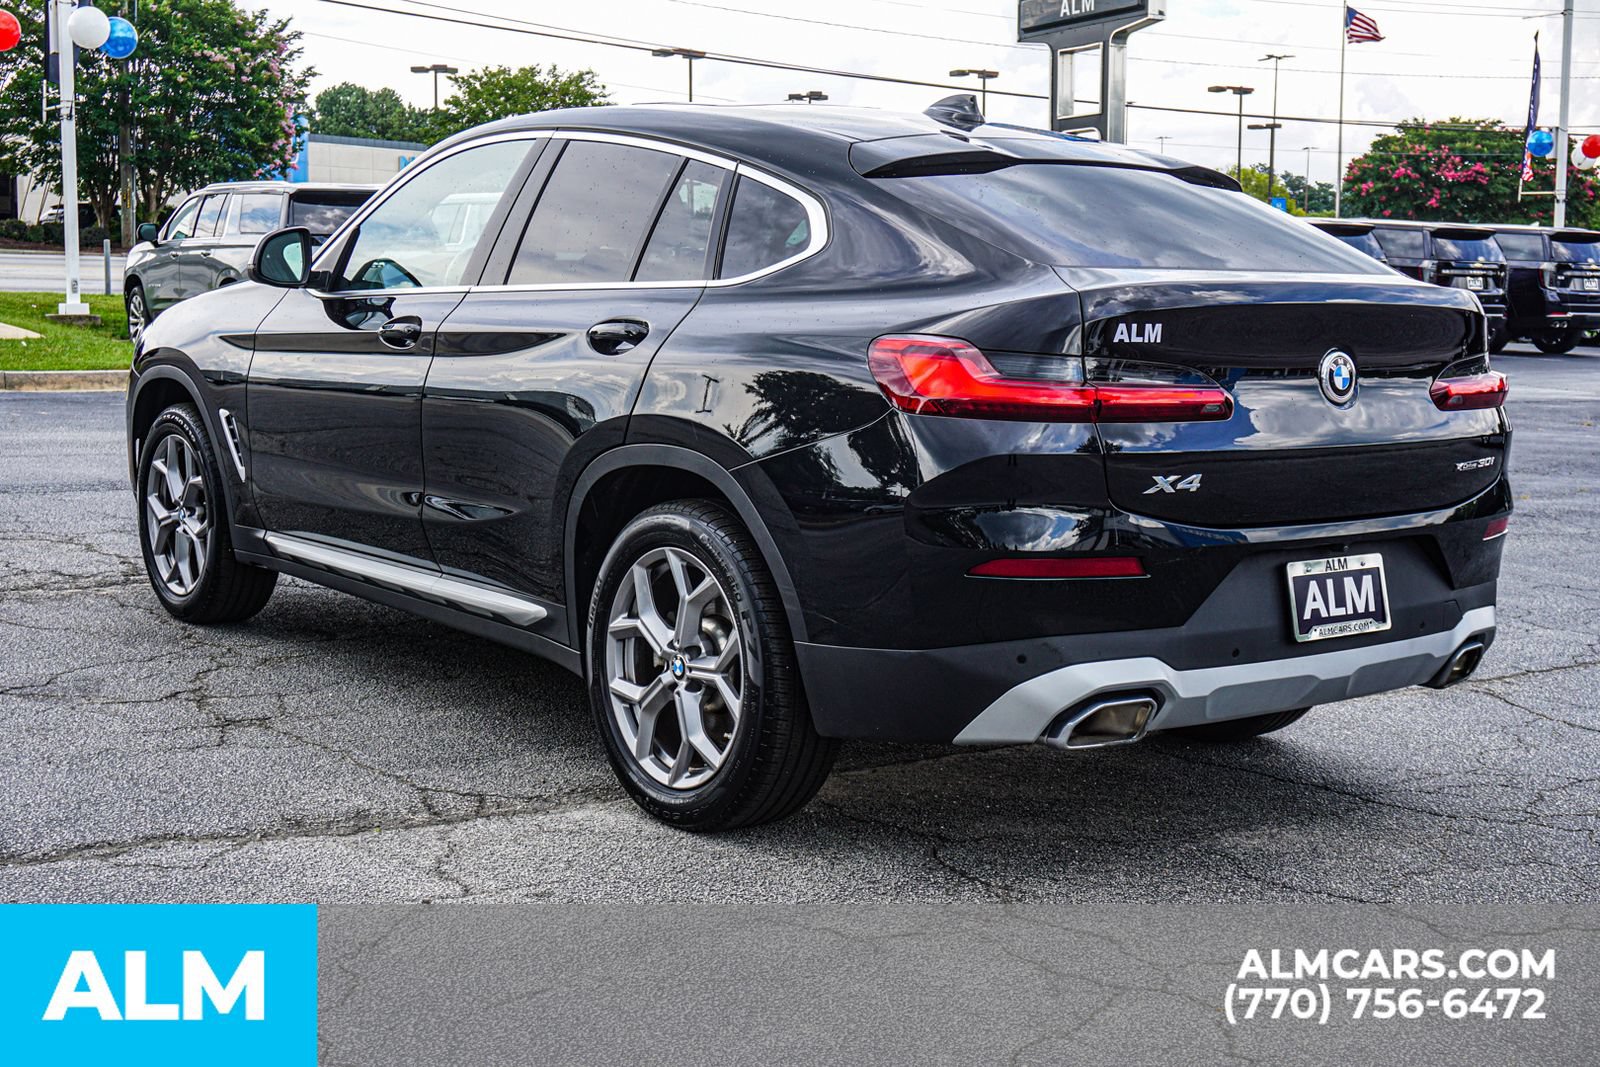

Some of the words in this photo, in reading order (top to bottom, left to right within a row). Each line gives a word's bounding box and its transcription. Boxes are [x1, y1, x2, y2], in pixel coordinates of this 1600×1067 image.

[1059, 0, 1095, 17] ALM
[1113, 323, 1162, 343] ALM
[1330, 358, 1351, 371] BMW
[1142, 474, 1203, 494] X4
[1325, 558, 1348, 572] ALM
[1303, 575, 1376, 620] ALM
[1319, 622, 1370, 636] ALMCARS.COM
